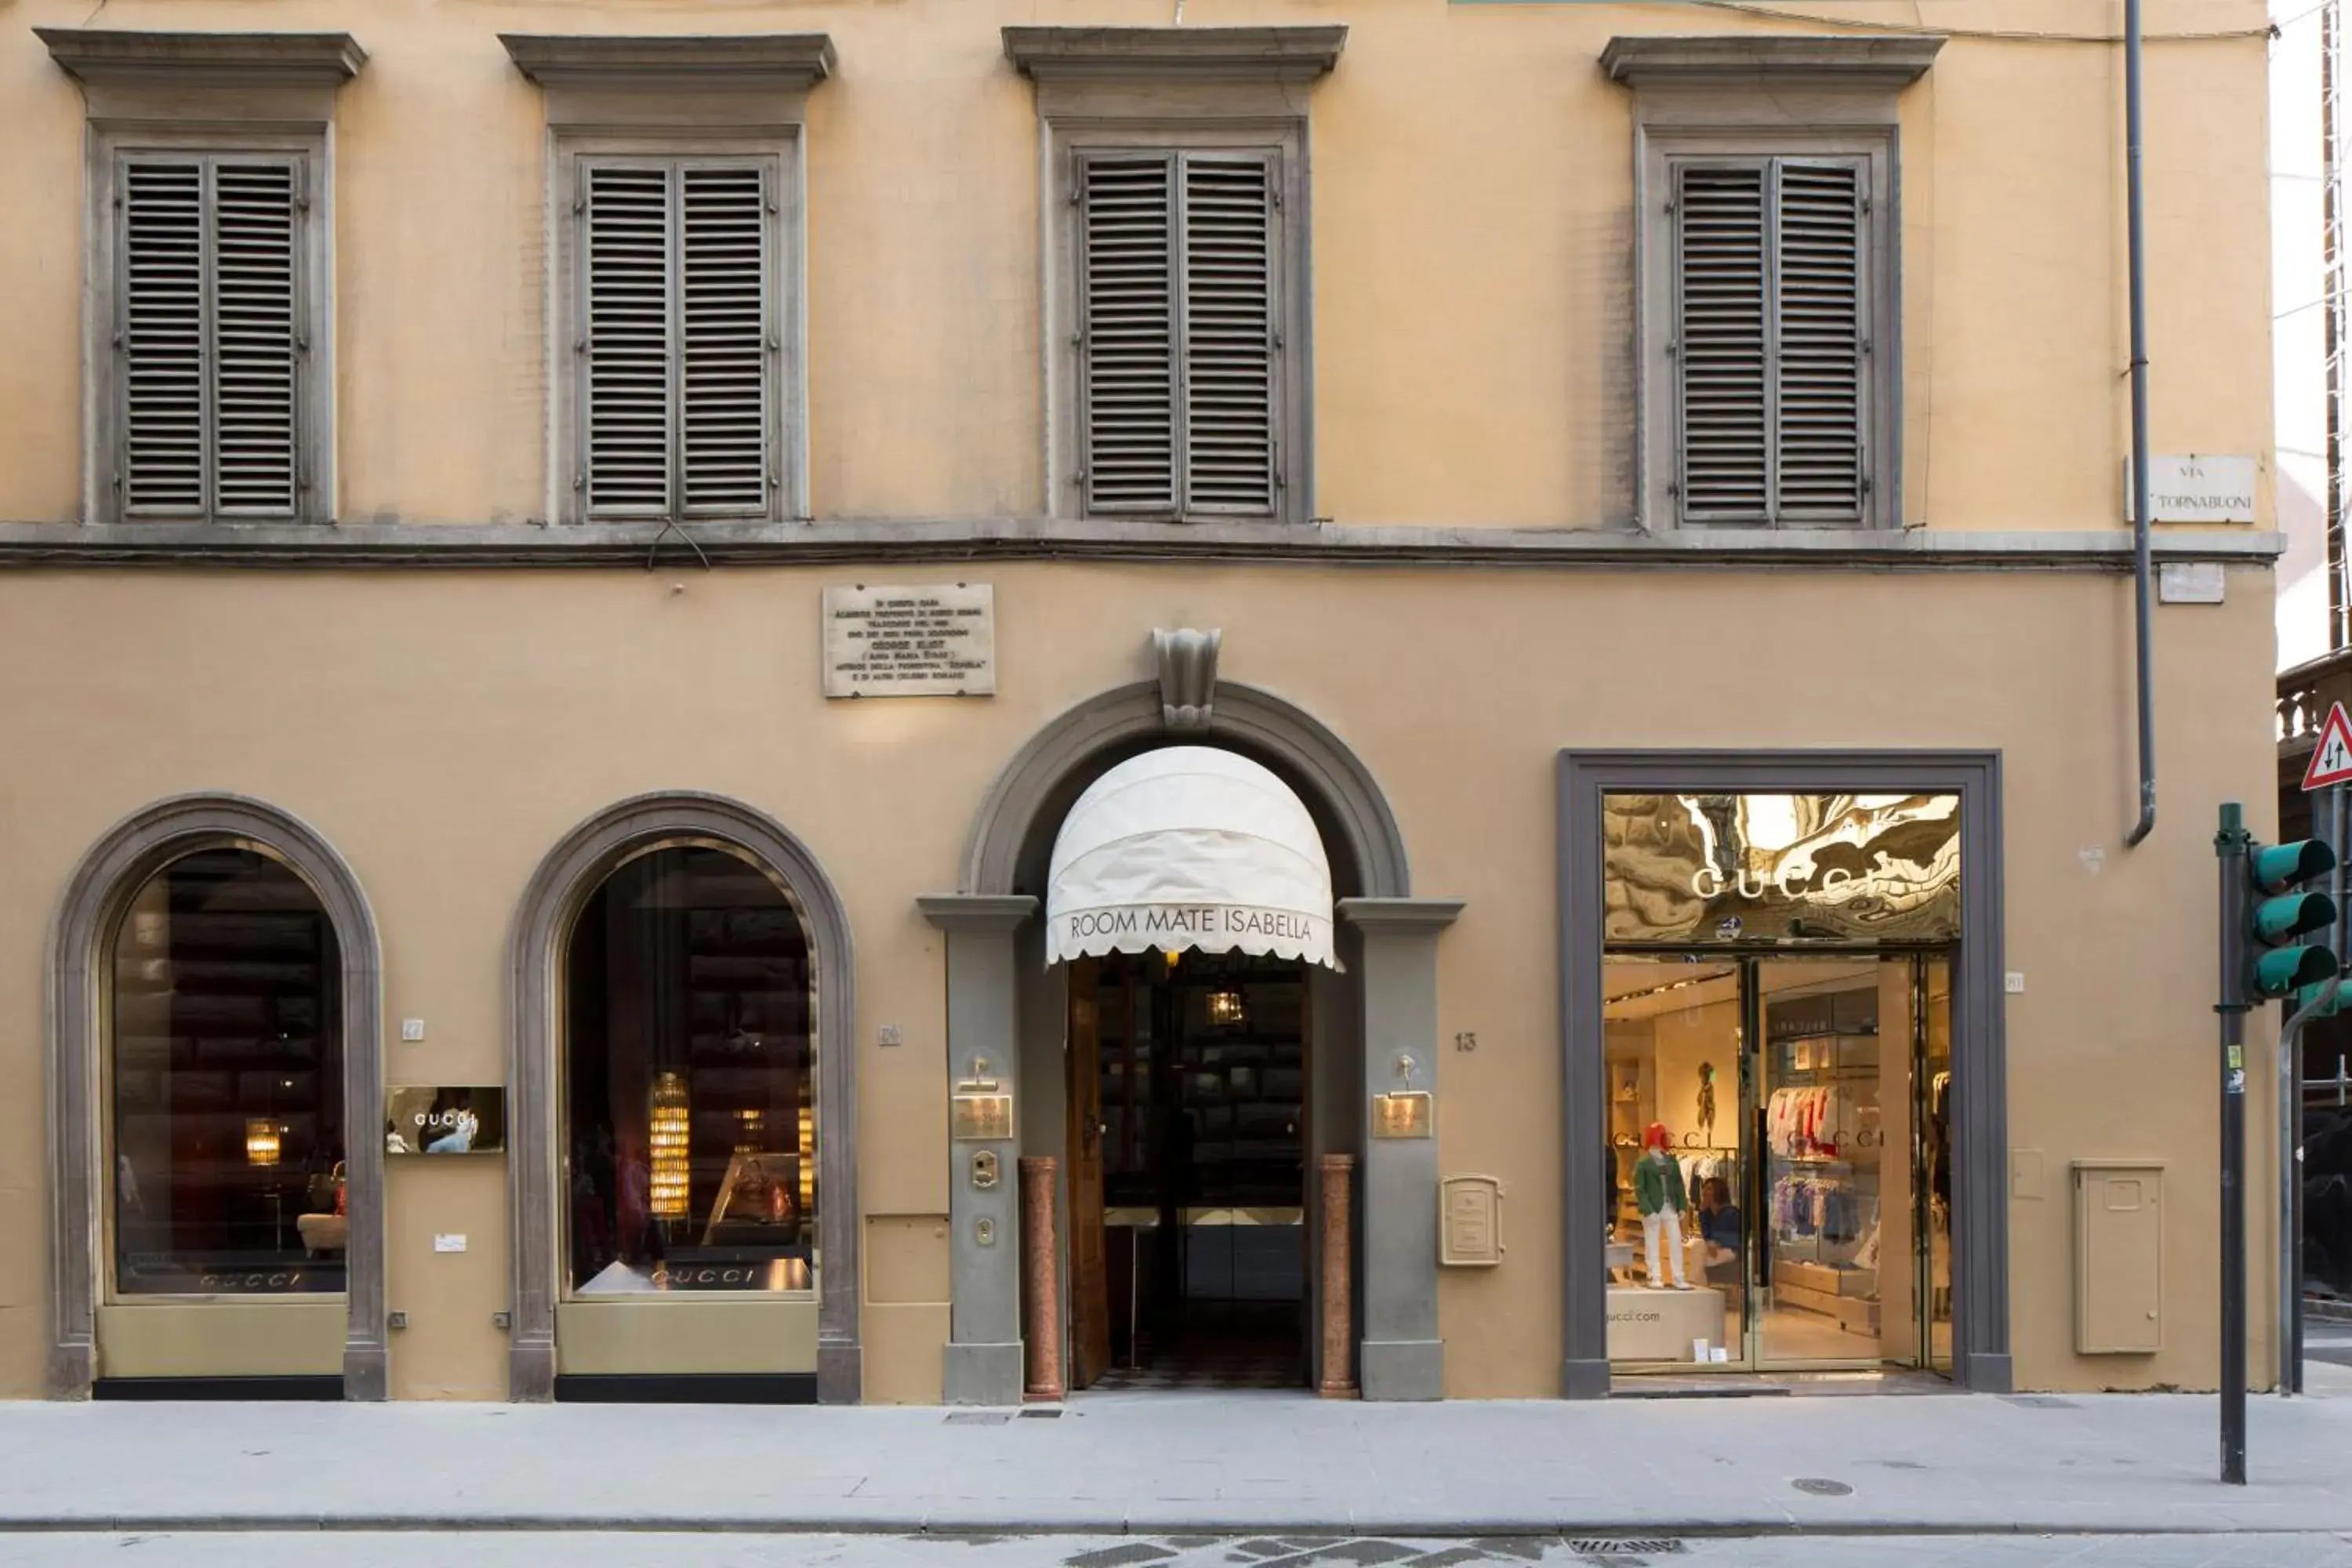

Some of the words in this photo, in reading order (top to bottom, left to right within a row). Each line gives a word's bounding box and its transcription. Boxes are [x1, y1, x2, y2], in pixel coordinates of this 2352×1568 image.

[2180, 466, 2205, 477] VIA
[2159, 495, 2251, 509] TORNABUONI
[1691, 867, 1875, 899] GUCCI
[1071, 912, 1138, 938] ROOM
[1145, 909, 1214, 934] MATE
[1225, 909, 1312, 942] ISABELLA
[1454, 1032, 1476, 1051] 13
[414, 1113, 476, 1126] GUCCI
[200, 1273, 300, 1287] GUCCI
[652, 1269, 753, 1283] GUCCI
[1607, 1311, 1660, 1322] ucci.com
